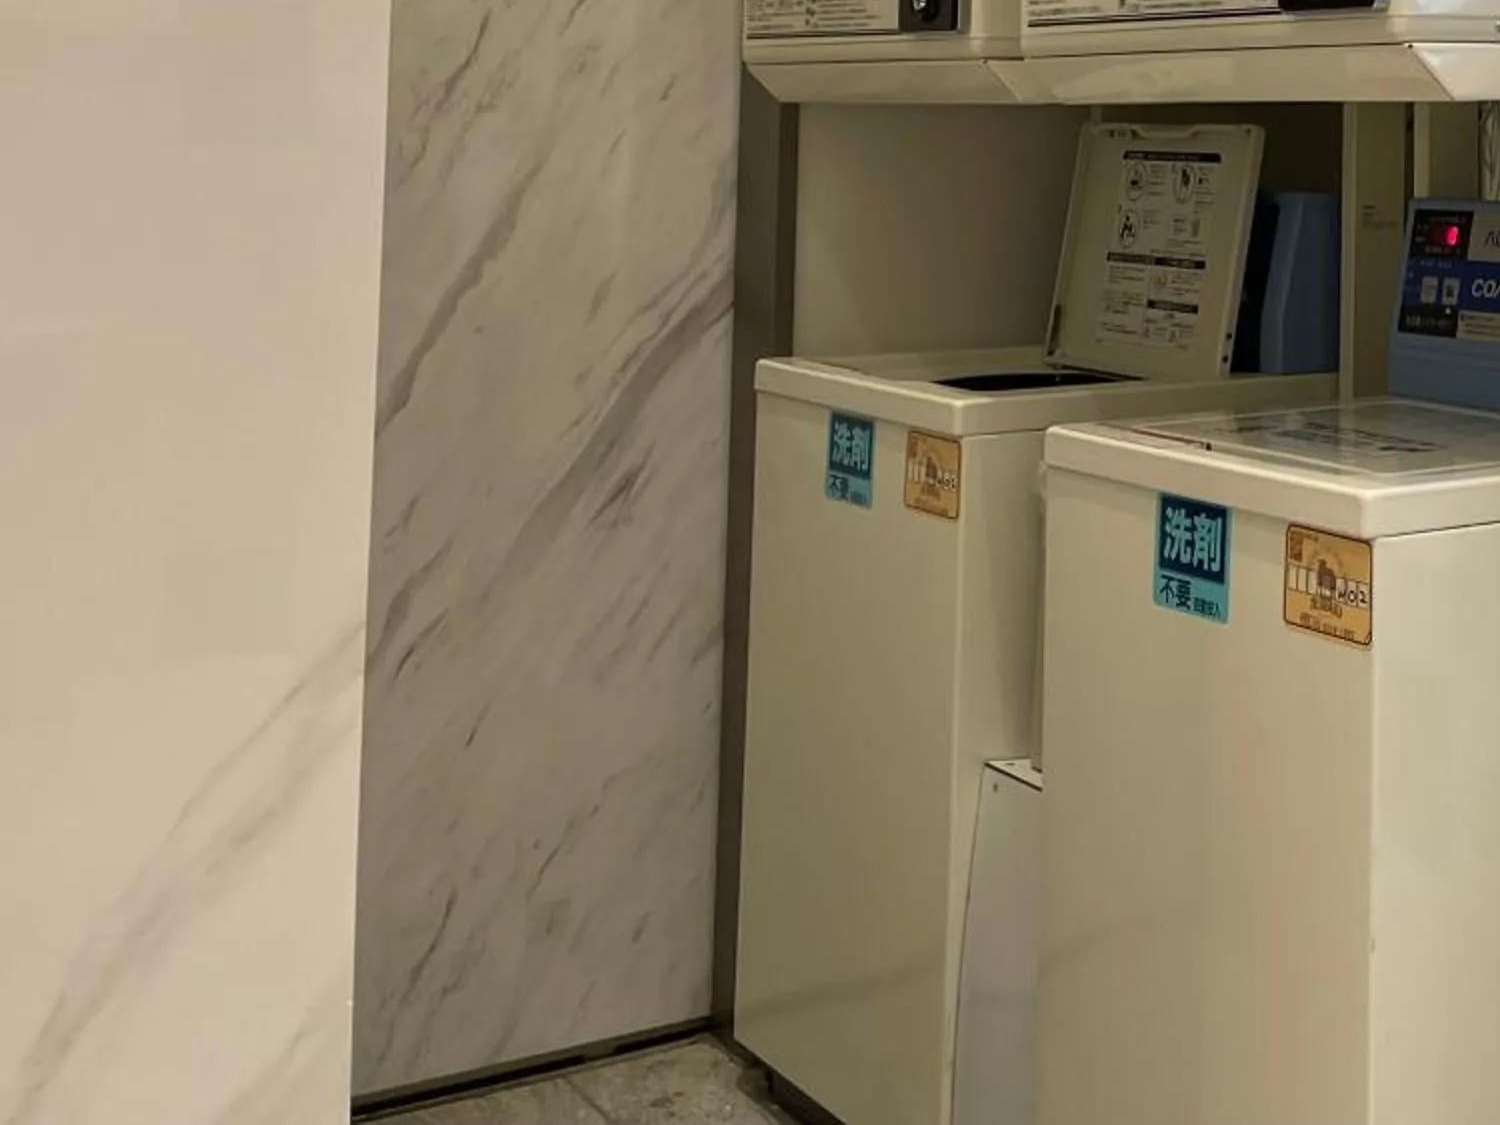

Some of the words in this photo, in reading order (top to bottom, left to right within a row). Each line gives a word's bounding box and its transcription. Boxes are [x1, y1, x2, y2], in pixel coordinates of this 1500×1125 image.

[832, 419, 871, 472] 洗剤
[1164, 506, 1222, 572] 洗剤
[1159, 574, 1191, 612] 不要
